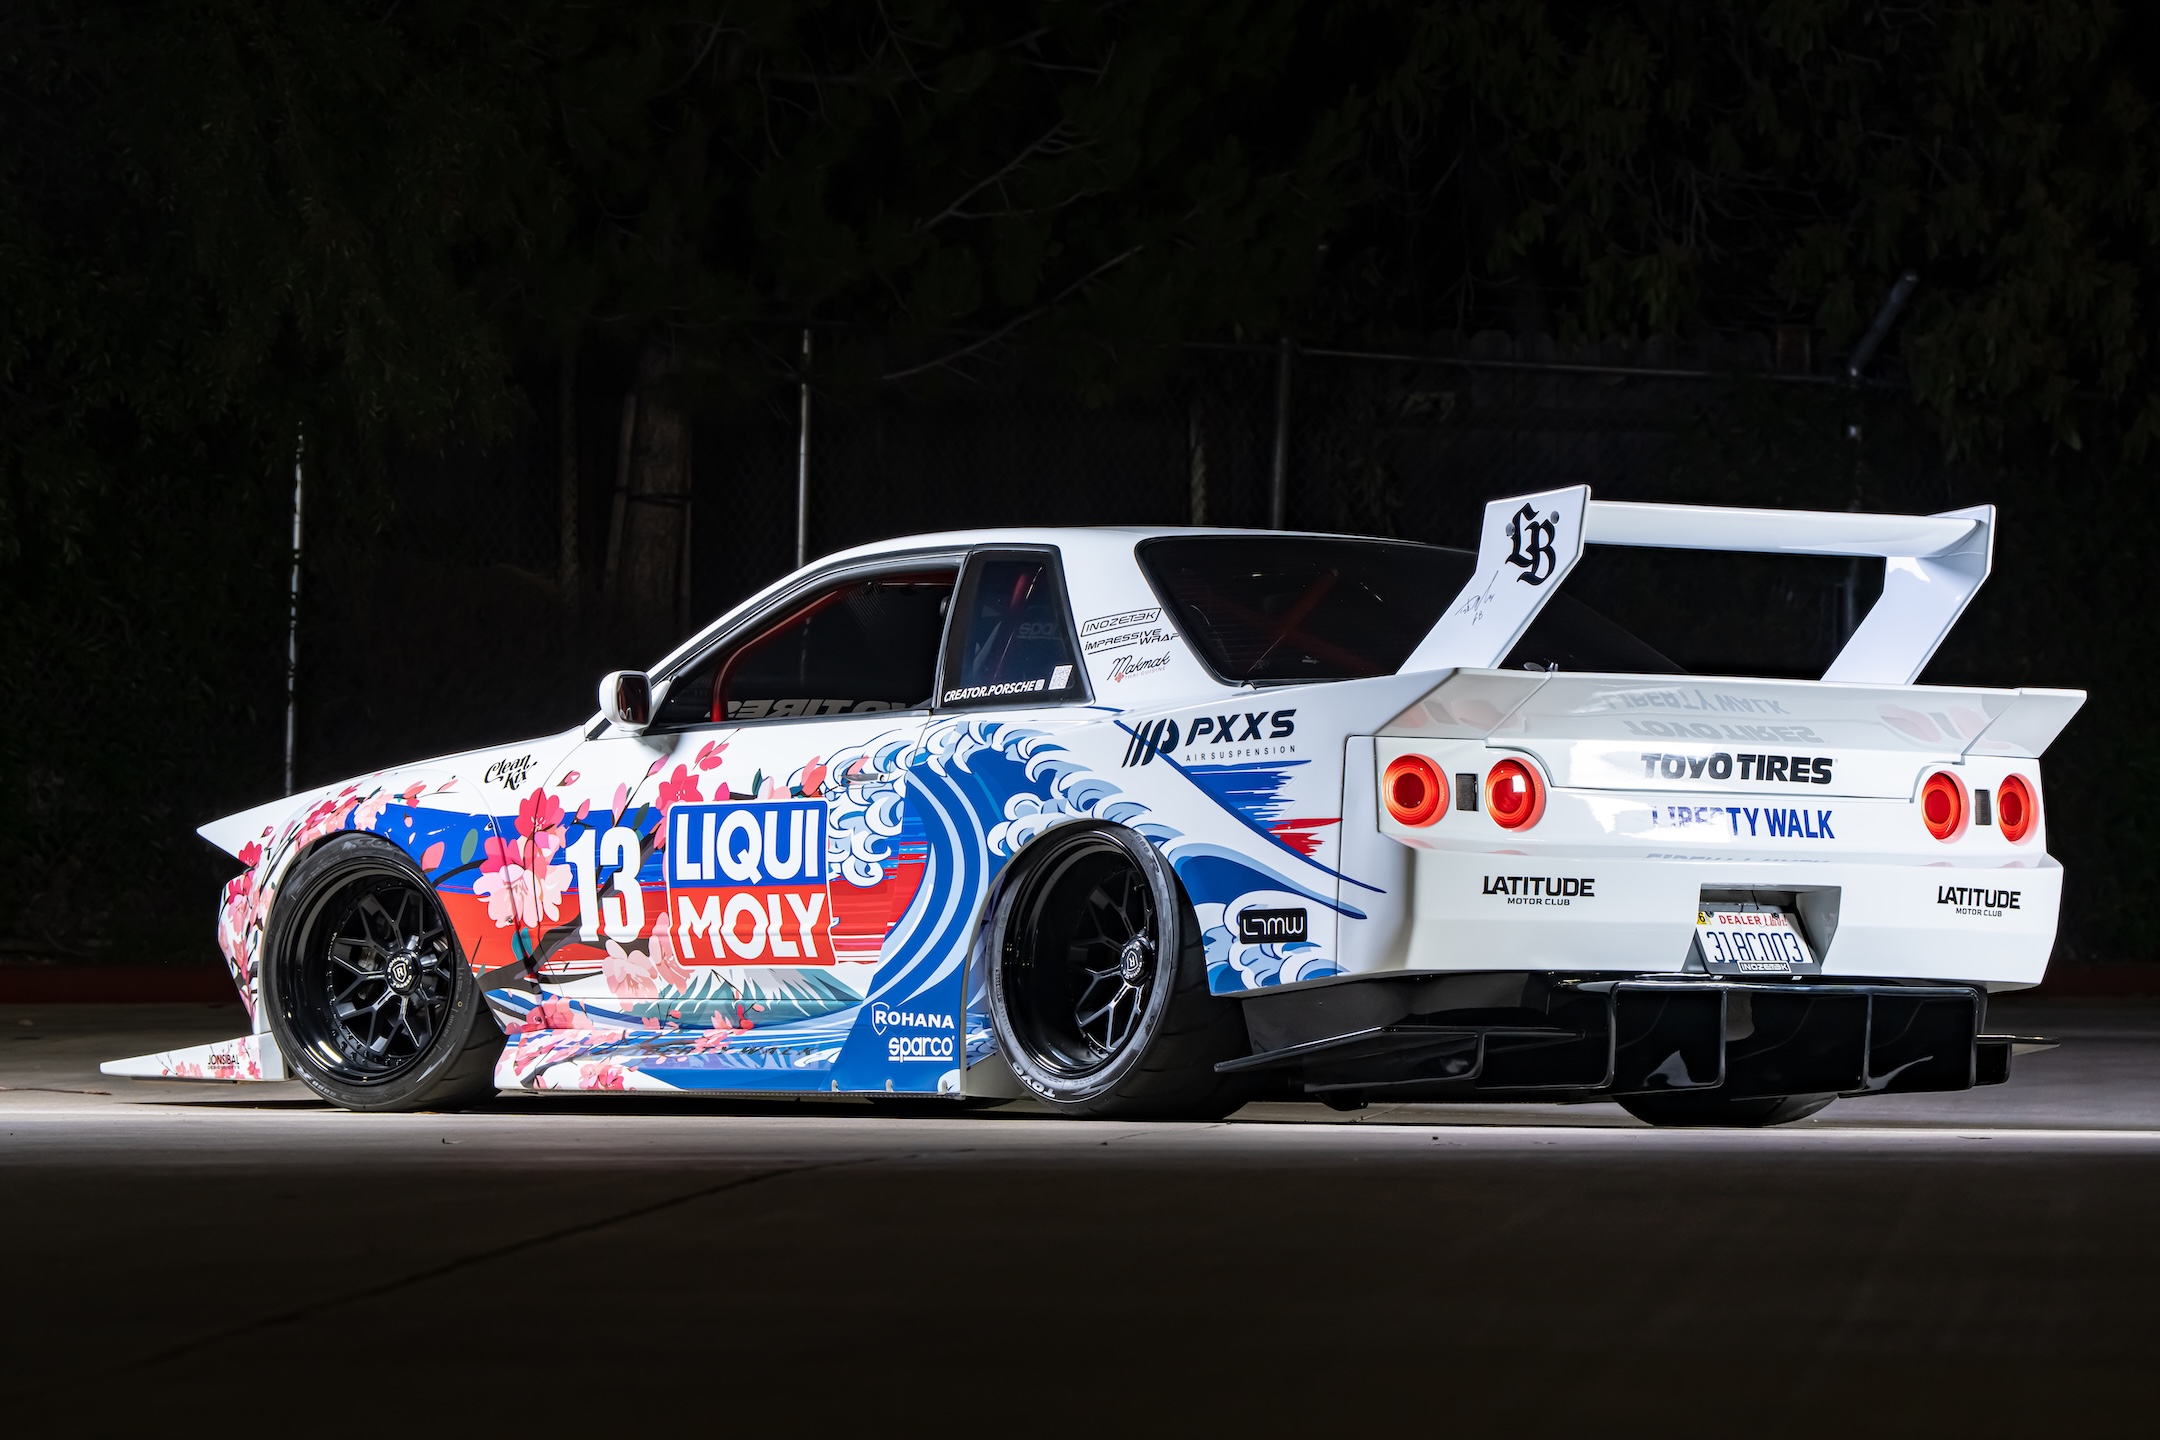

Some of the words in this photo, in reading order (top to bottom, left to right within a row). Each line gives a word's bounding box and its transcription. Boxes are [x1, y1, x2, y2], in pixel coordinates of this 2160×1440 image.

[1107, 651, 1171, 681] Makmak
[943, 680, 1036, 703] CREATOR.PORSCHE
[1185, 708, 1297, 747] PXXS
[484, 754, 531, 784] Clean
[1640, 752, 1733, 780] TOYO
[1736, 753, 1833, 785] TIRES
[1763, 808, 1836, 839] WALK
[676, 808, 820, 885] LIQUI
[565, 826, 646, 943] 13
[1482, 875, 1595, 897] LATITUDE
[1937, 885, 2021, 910] LATITUDE
[1507, 897, 1543, 906] MOTOR
[1544, 898, 1570, 906] CLUB
[1956, 907, 1982, 916] MOTOR
[1983, 909, 2002, 918] CLUB
[677, 892, 826, 960] MOLY
[1718, 914, 1763, 926] DEALER
[874, 1010, 955, 1030] ROHANA
[208, 1054, 240, 1065] JONSIBAL
[888, 1036, 953, 1063] sparco
[1012, 1061, 1056, 1098] TOYO
